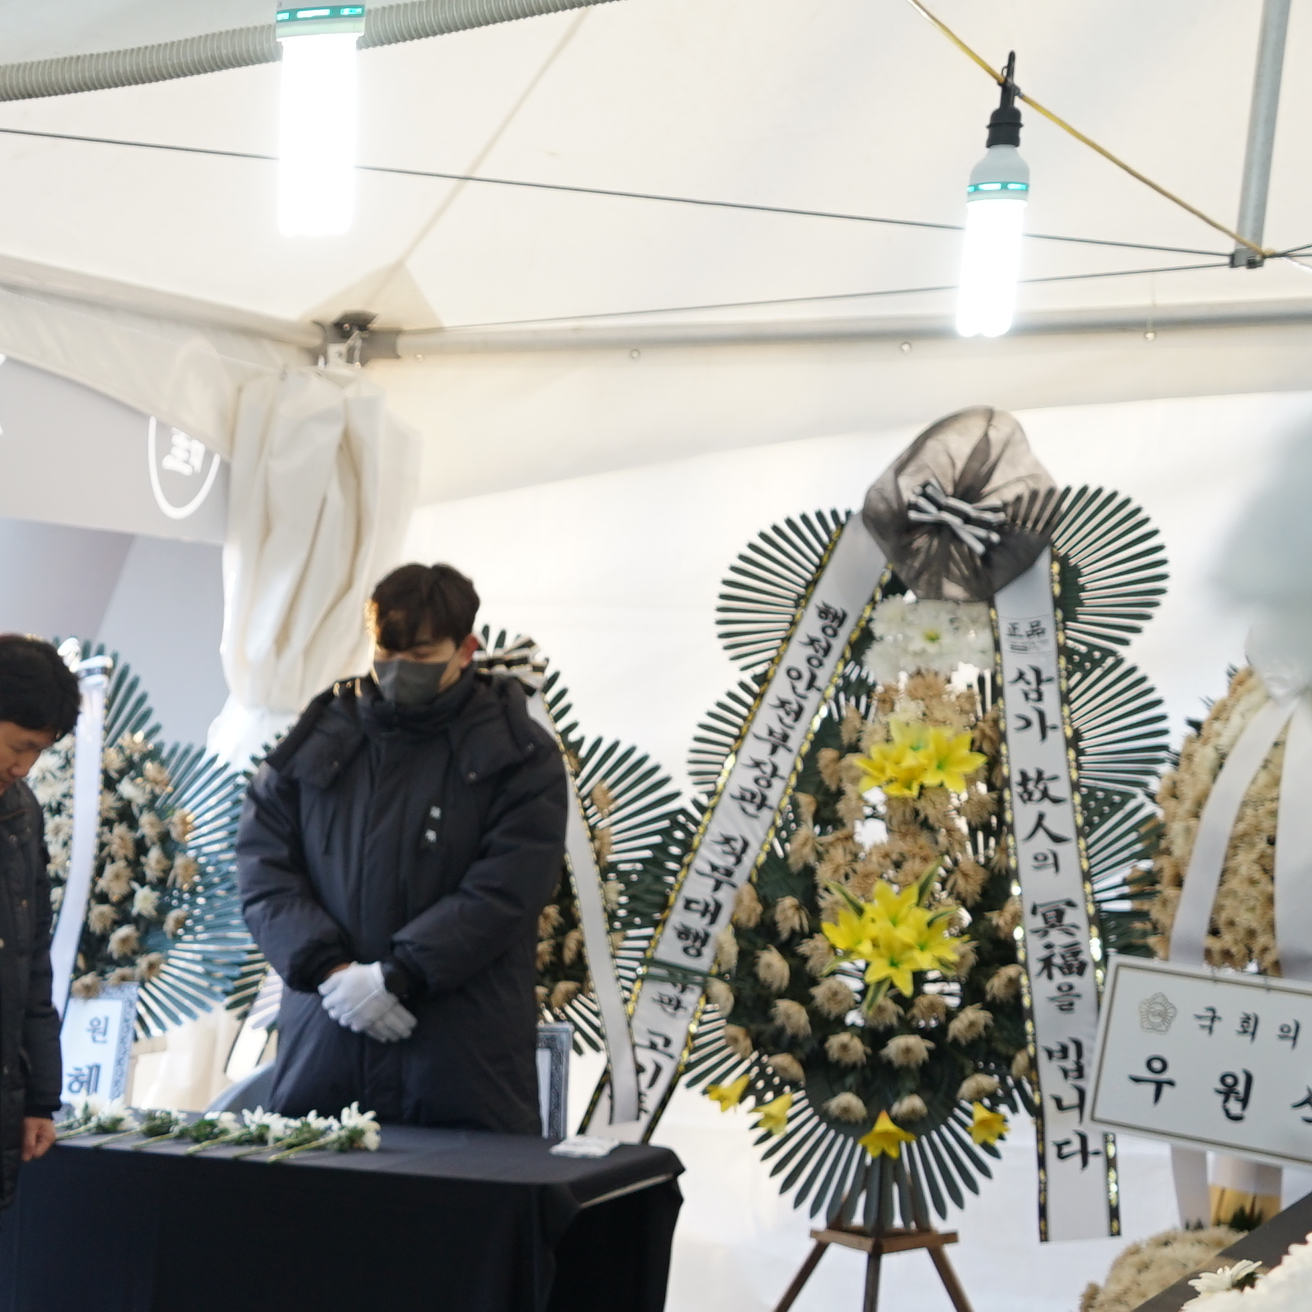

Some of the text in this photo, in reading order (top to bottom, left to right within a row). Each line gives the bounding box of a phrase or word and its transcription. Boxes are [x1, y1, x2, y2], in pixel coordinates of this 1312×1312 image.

[1008, 664, 1104, 1172] 삼가 故人의 冥福을 빕니다
